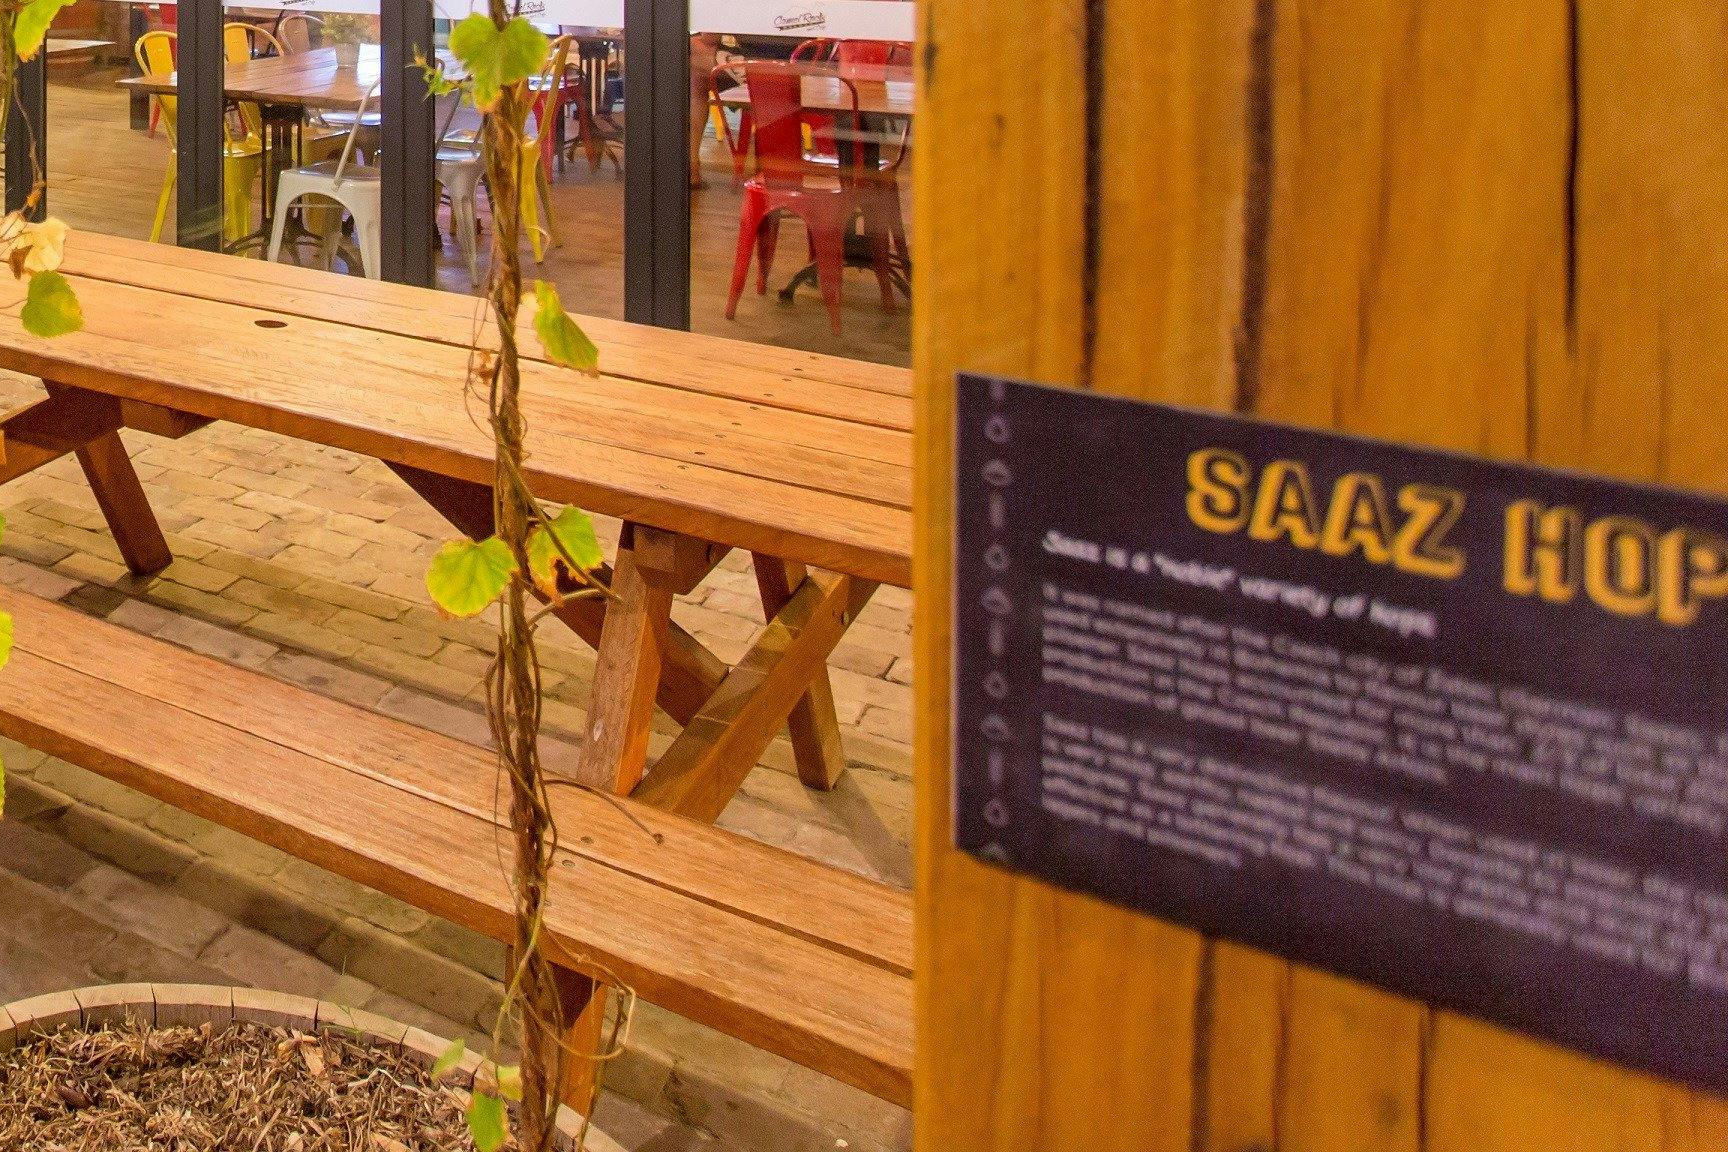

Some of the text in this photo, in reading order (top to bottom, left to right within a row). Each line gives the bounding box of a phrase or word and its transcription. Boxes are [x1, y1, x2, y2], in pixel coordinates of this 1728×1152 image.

[1185, 448, 1728, 626] SAAZ HOP
[1238, 576, 1330, 618] variety
[1332, 593, 1366, 620] of
